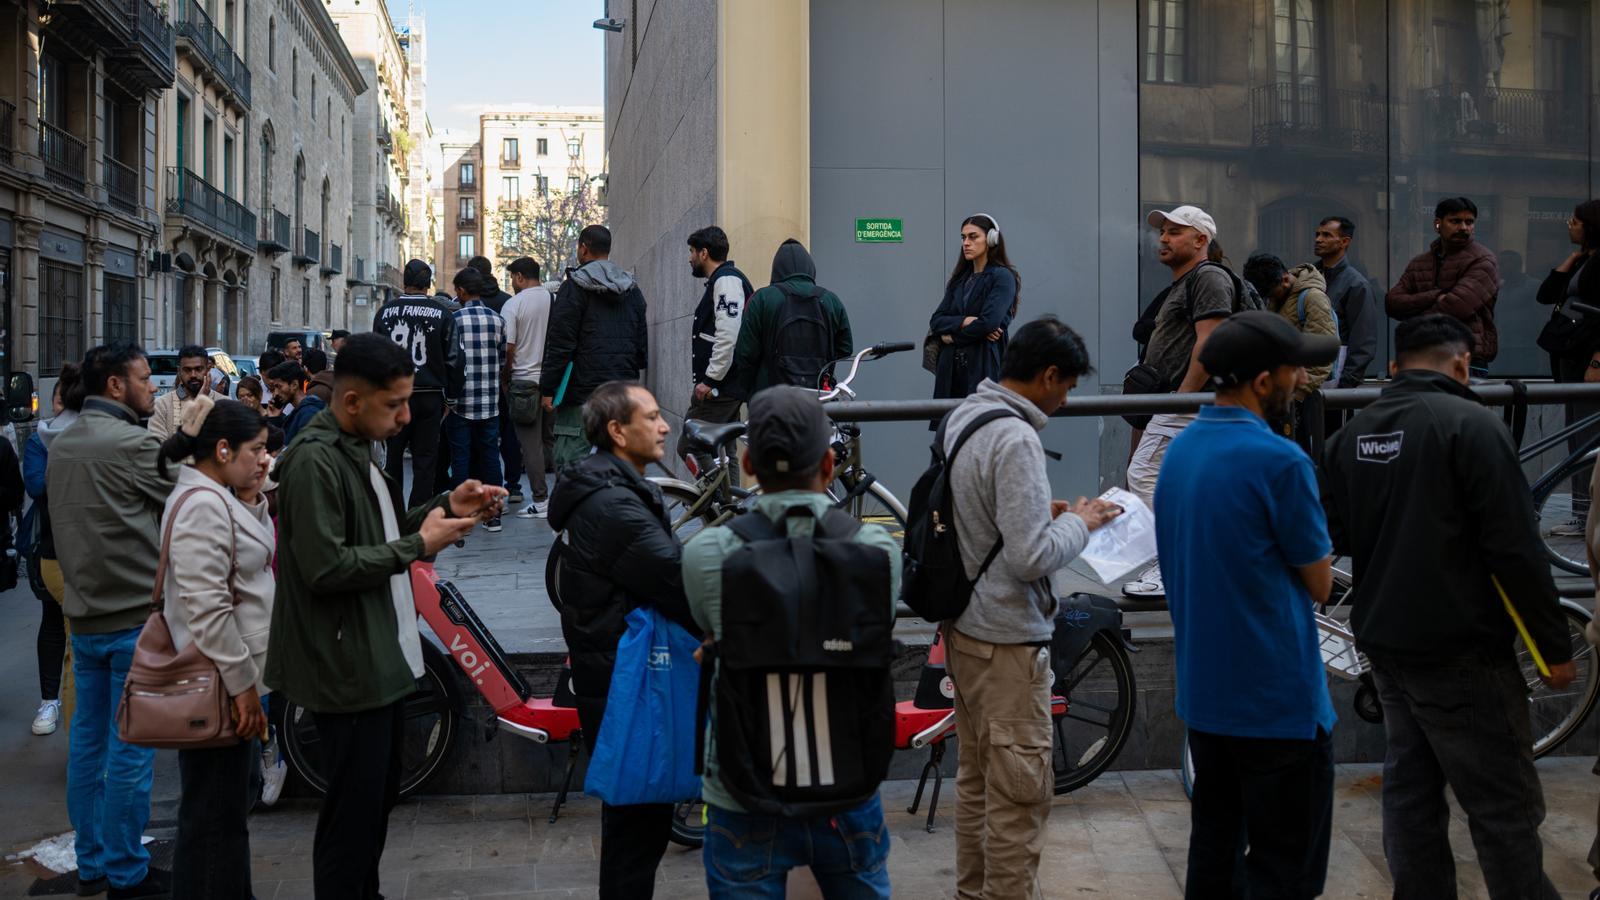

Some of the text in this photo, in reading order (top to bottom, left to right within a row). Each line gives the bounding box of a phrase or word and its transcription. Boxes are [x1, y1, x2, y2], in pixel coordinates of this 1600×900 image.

[866, 222, 892, 230] SORTIDA
[401, 305, 443, 319] FANGORIA
[716, 294, 738, 318] AC
